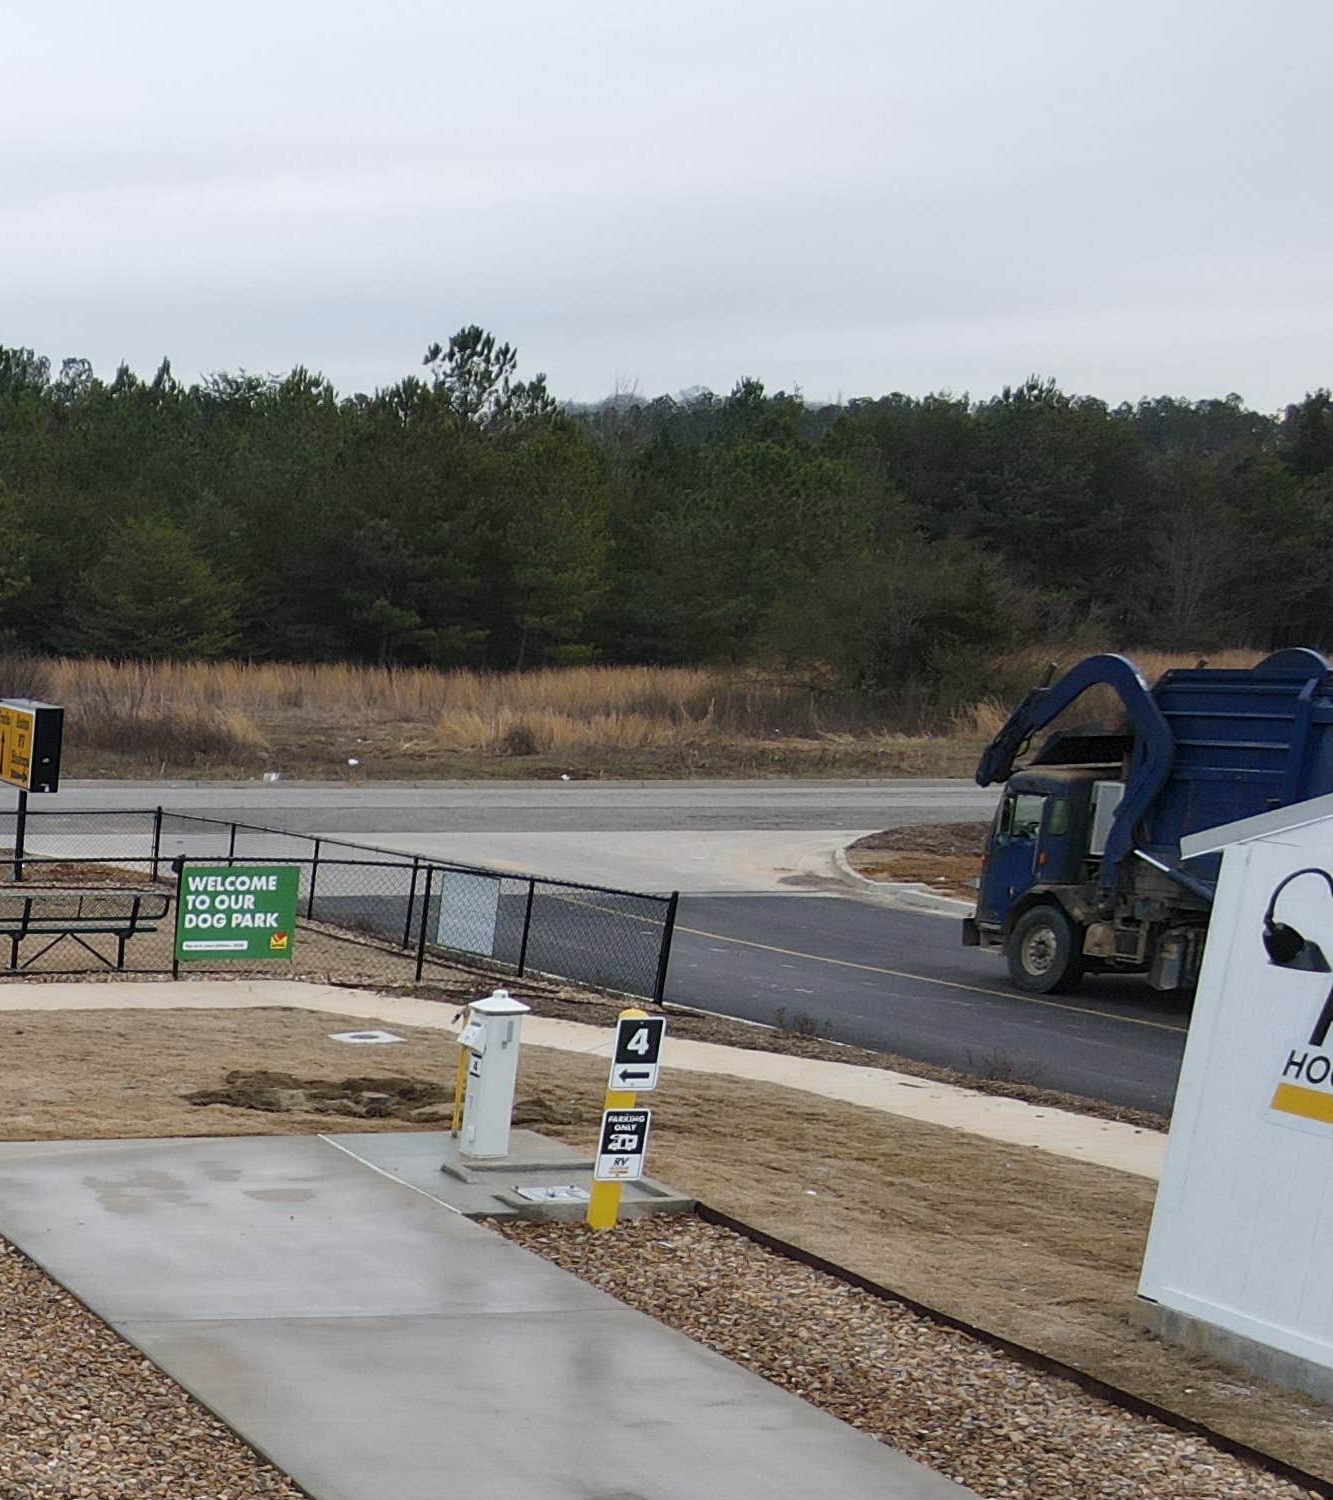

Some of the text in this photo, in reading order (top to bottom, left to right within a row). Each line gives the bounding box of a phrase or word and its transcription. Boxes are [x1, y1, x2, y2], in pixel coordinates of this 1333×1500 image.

[187, 876, 278, 891] WELCOME
[186, 894, 255, 910] TO OUR
[184, 912, 279, 929] DOG PARK
[626, 1028, 650, 1055] 4
[1282, 1049, 1333, 1088] HO
[608, 1115, 645, 1123] PARKING
[613, 1157, 629, 1166] RV
